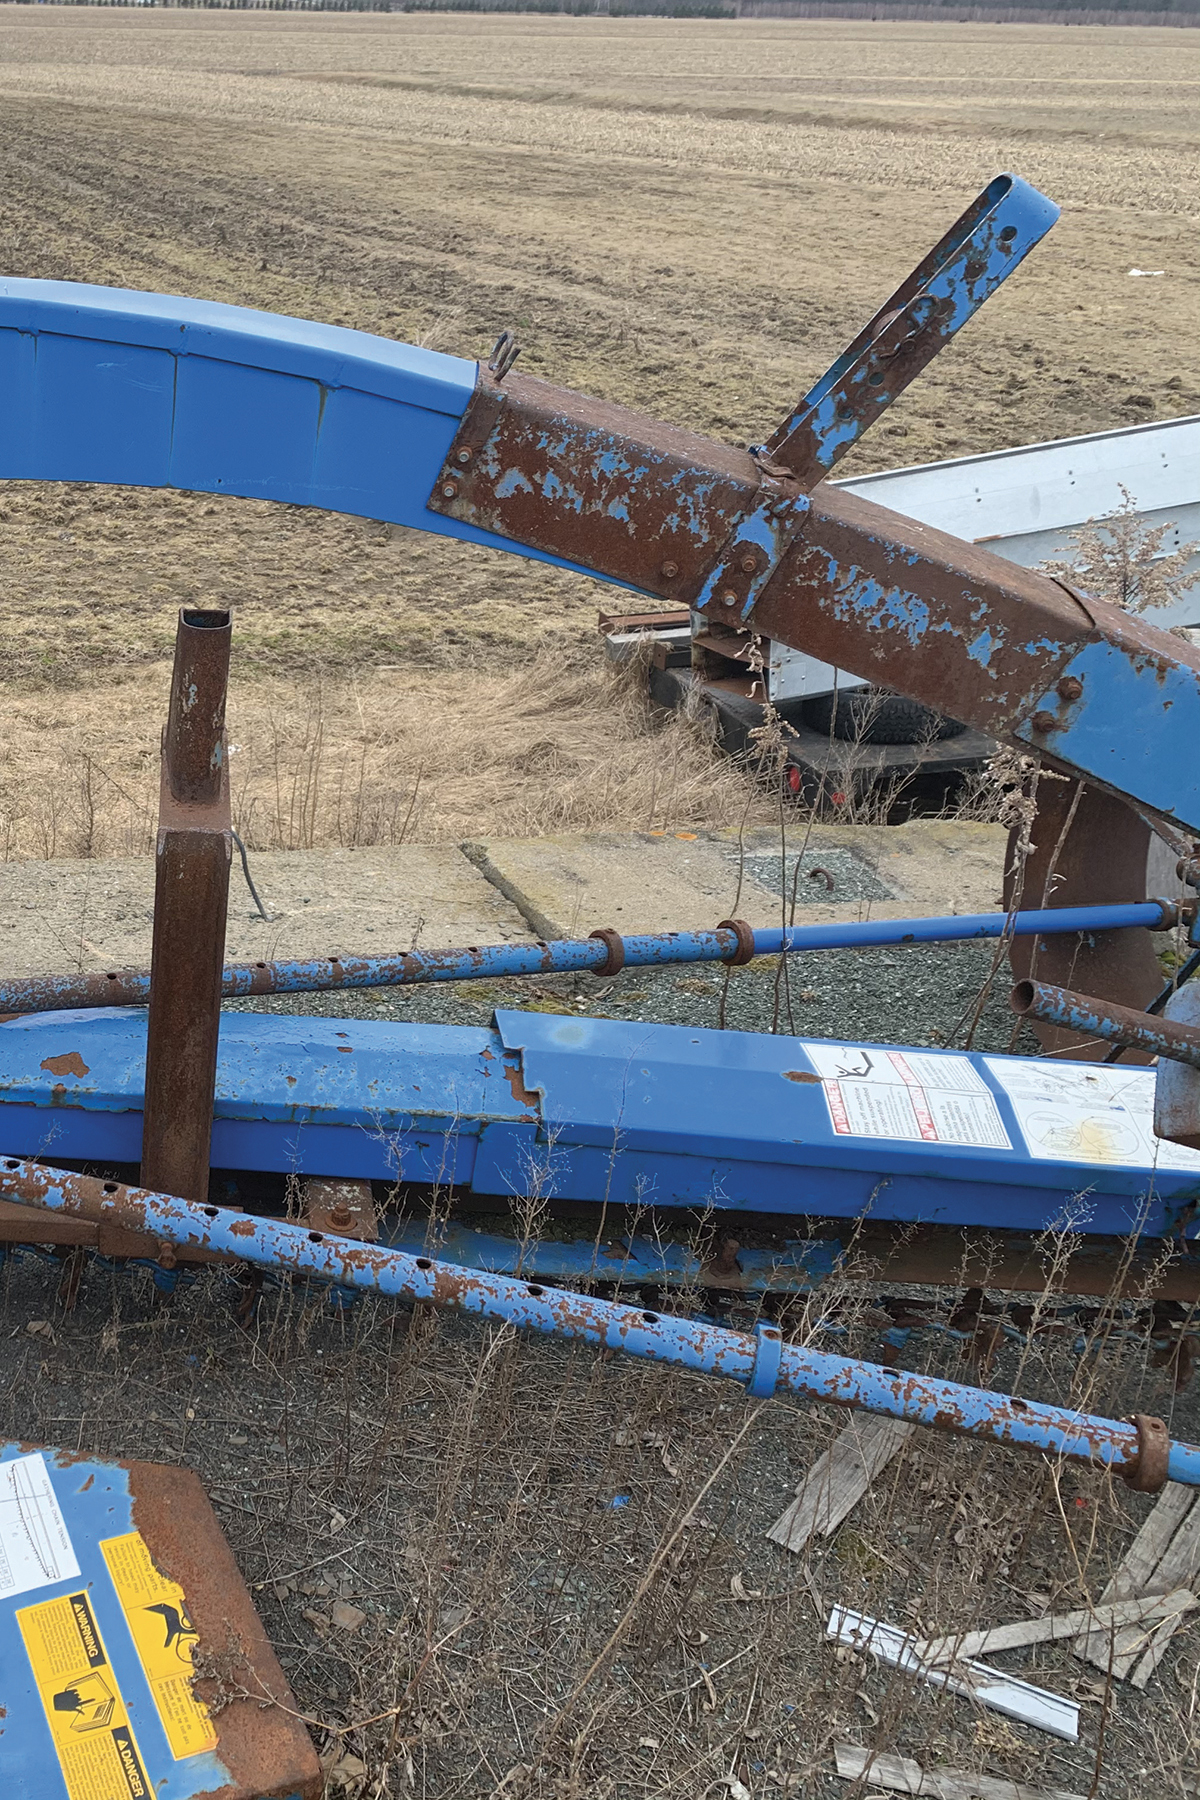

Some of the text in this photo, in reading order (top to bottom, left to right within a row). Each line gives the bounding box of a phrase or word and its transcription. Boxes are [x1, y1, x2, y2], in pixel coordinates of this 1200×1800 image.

[852, 1086, 872, 1133] Stay off machine
[862, 1087, 877, 1118] suspended
[40, 1478, 69, 1550] GATHERING CHAIN TENSION
[75, 1609, 99, 1658] WARNING
[120, 1748, 145, 1797] DANGER
